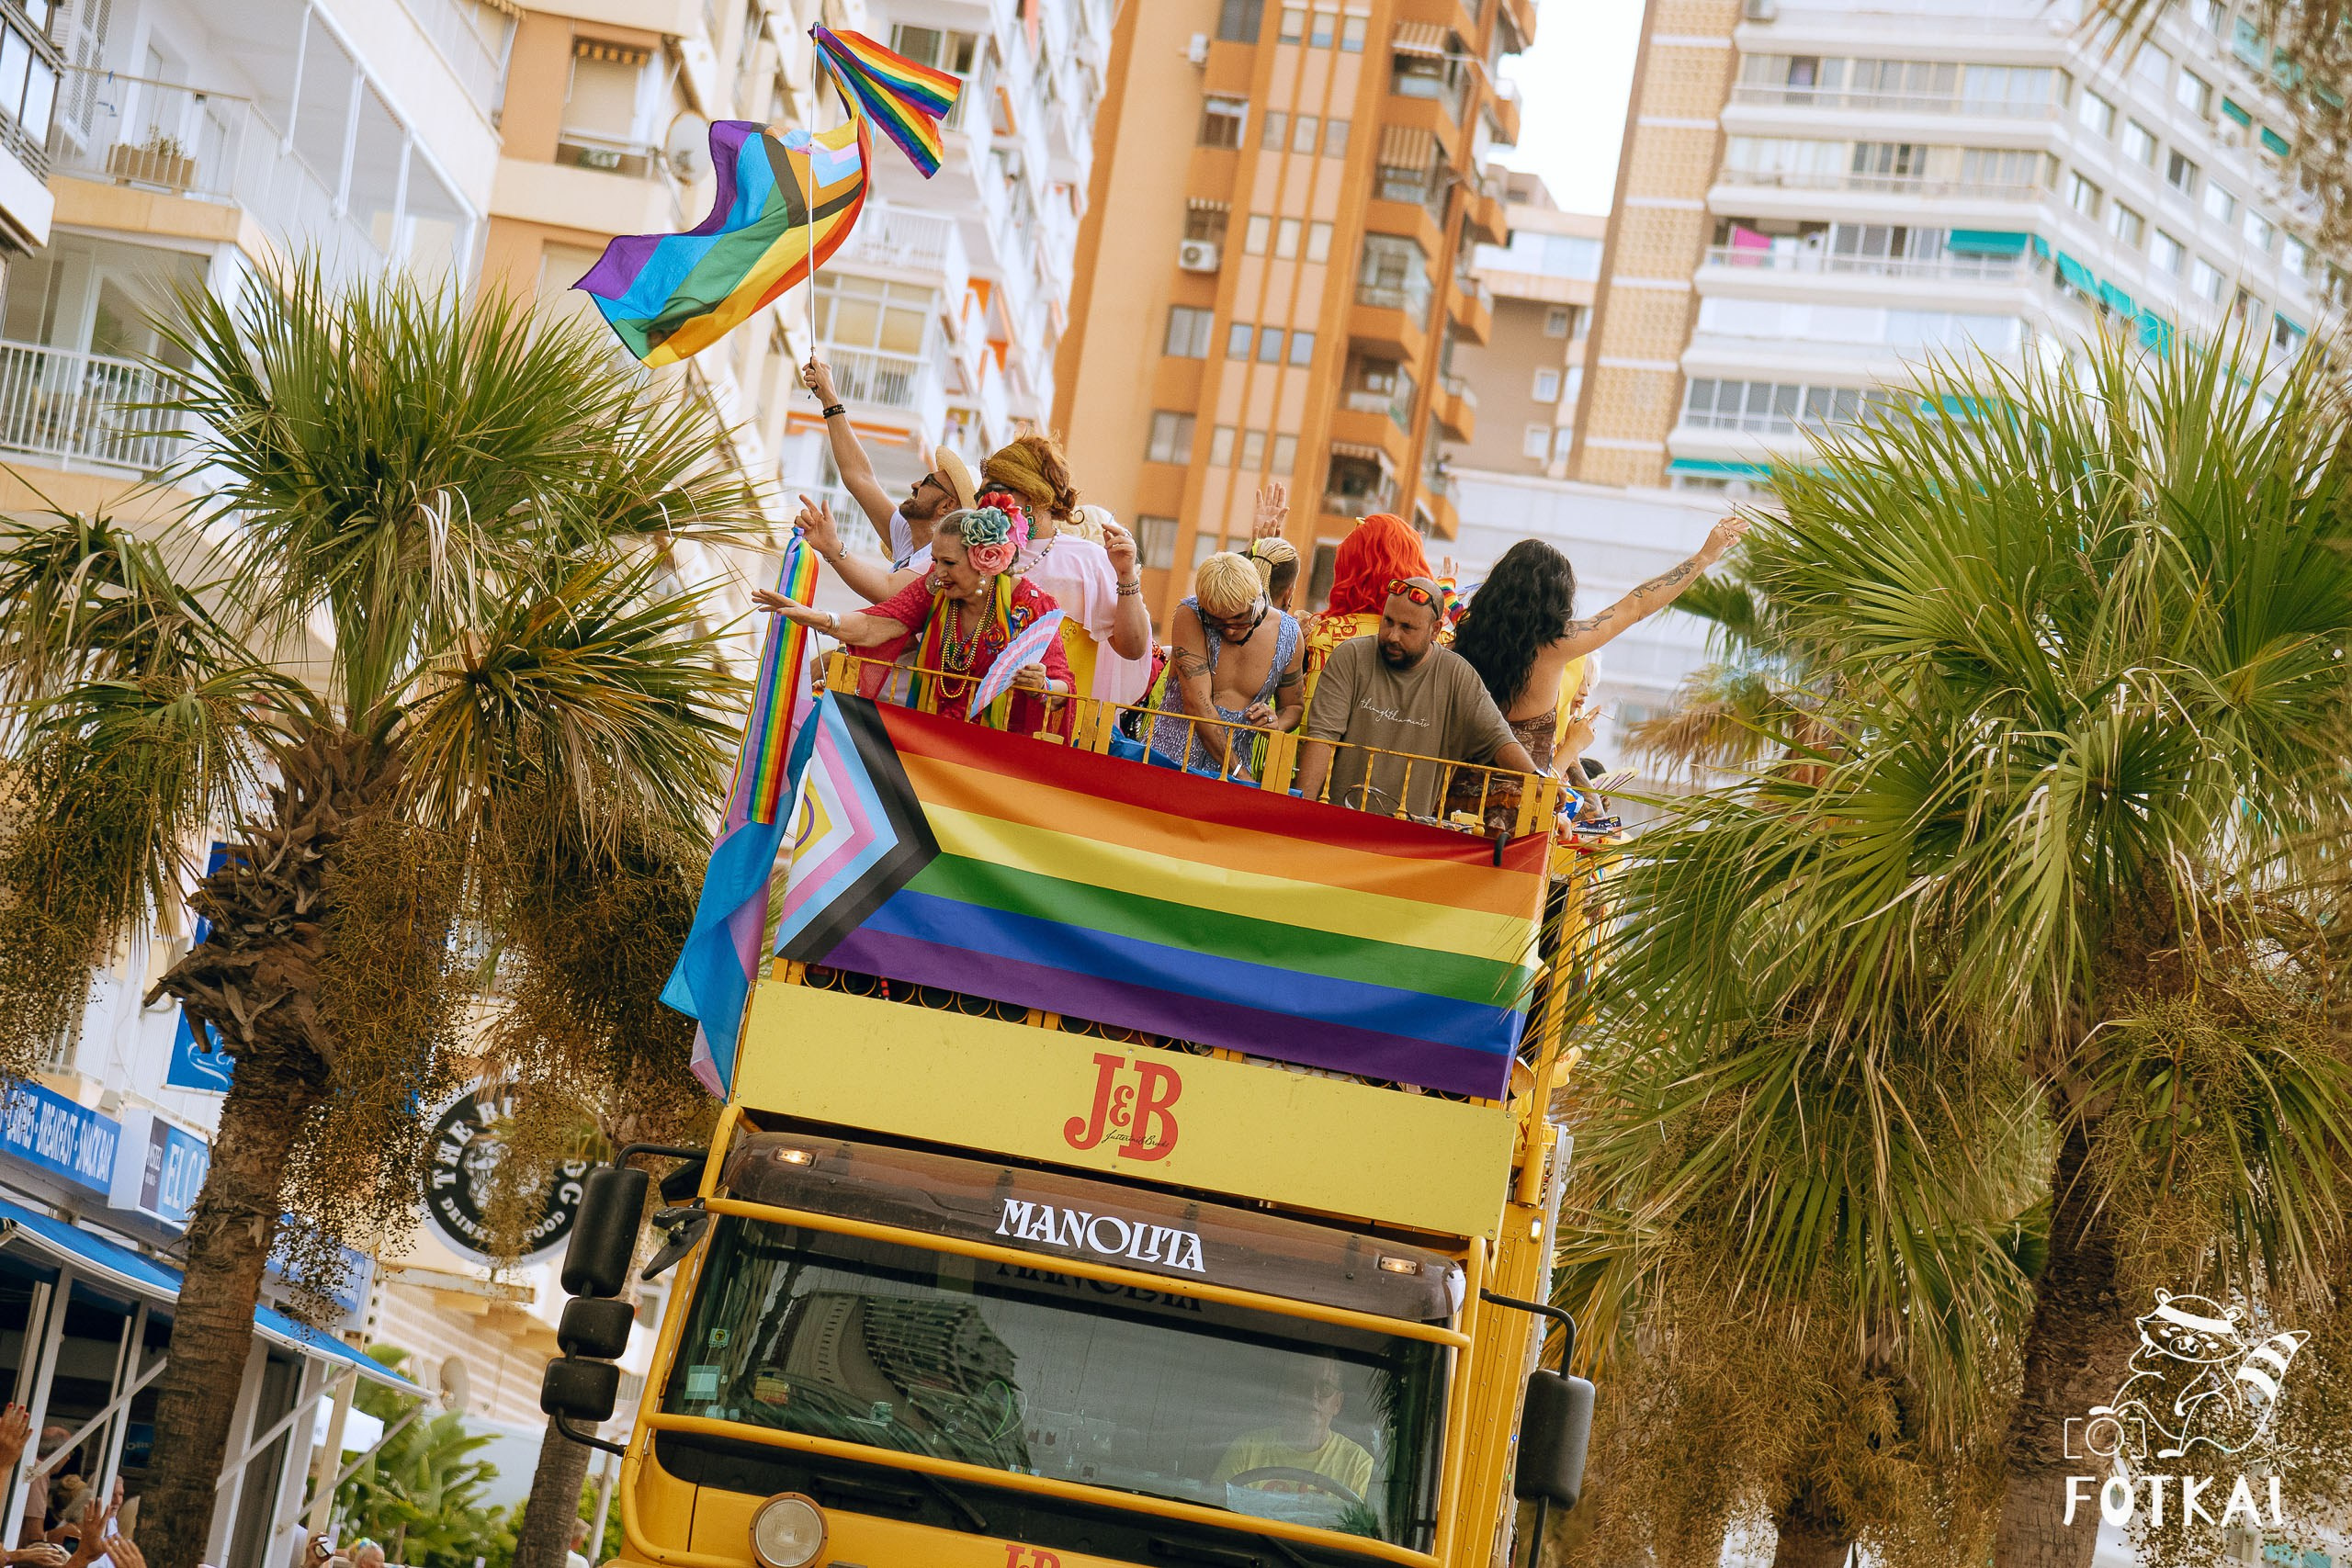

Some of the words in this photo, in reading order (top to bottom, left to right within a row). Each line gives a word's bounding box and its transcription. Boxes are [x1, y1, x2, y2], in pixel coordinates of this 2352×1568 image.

[36, 1101, 79, 1167] BREAKFAST
[75, 1119, 104, 1179] SNACK
[1063, 1052, 1182, 1162] J&B
[431, 1119, 475, 1190] THE
[995, 1198, 1206, 1273] MANOLITA
